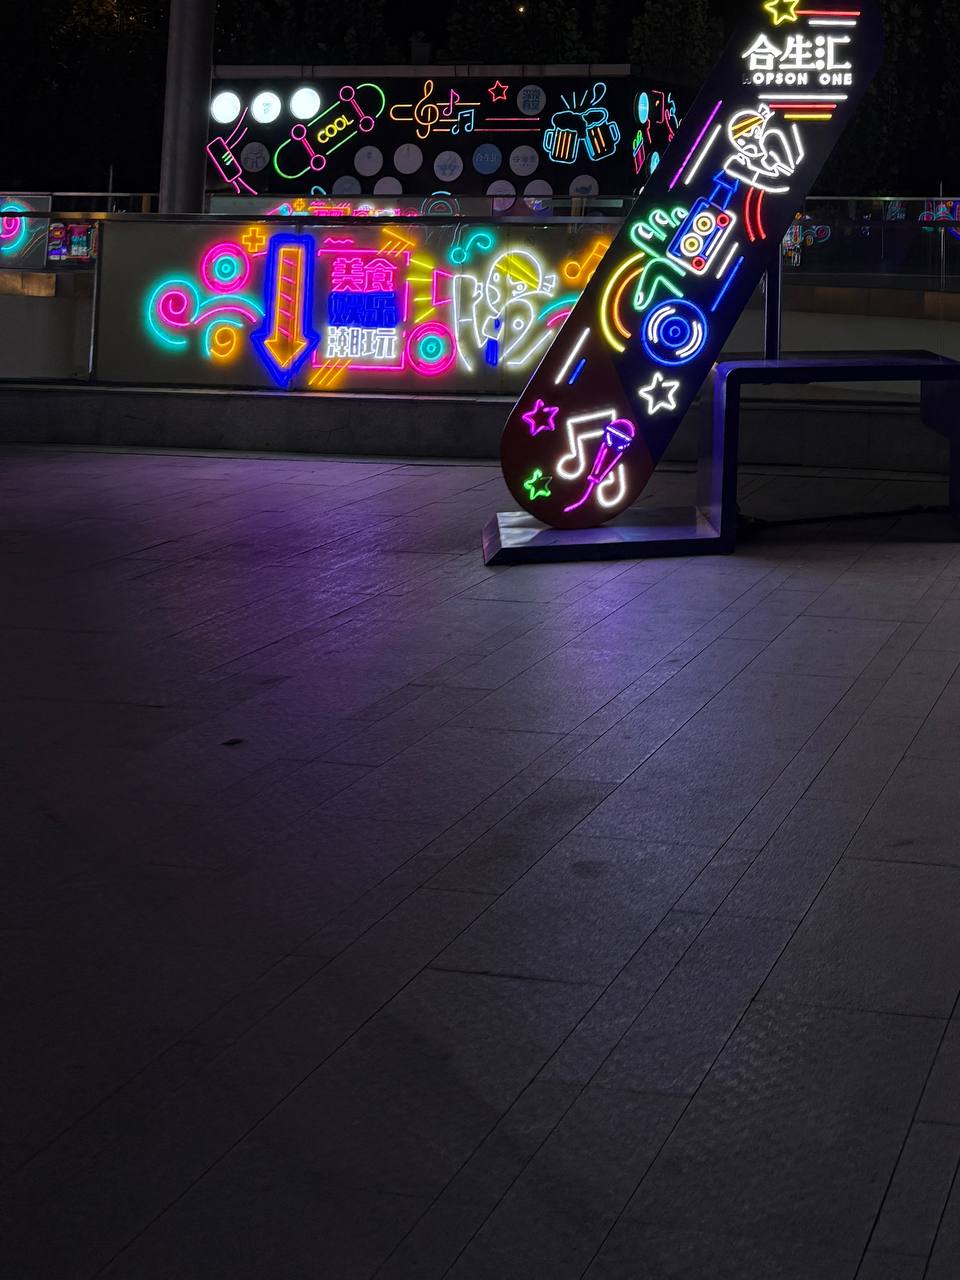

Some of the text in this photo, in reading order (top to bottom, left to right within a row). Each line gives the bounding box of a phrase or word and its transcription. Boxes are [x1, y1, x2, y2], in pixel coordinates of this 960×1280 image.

[741, 33, 852, 70] 合生汇
[742, 72, 853, 85] OPSON ONE
[317, 114, 354, 144] COOL
[331, 257, 398, 292] 美食
[327, 326, 397, 358] 潮玩
